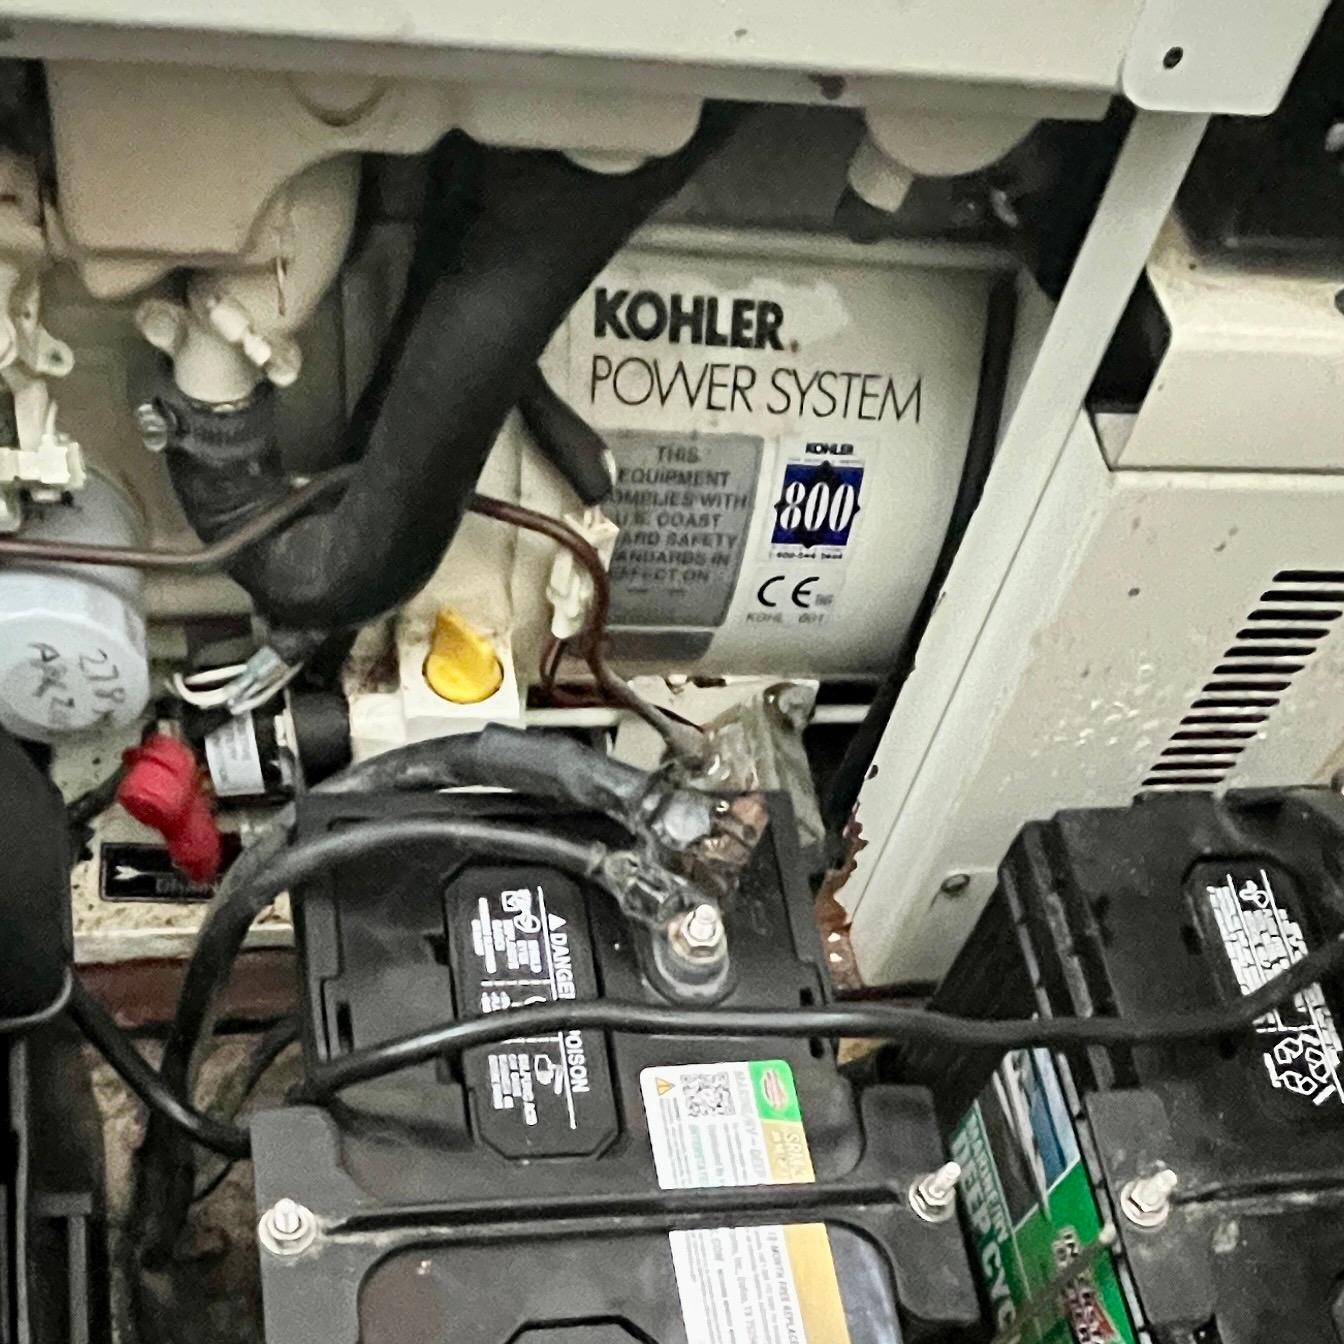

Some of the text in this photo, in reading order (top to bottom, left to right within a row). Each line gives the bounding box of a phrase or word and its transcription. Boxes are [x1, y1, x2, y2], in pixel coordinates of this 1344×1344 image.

[594, 287, 784, 351] KOHLER
[591, 355, 922, 423] POWER SYSTEM
[658, 446, 700, 463] THIS
[806, 443, 853, 455] KOHLER
[618, 468, 731, 487] EQUIPMENT
[612, 489, 747, 508] OMPLIES WITH
[780, 482, 854, 531] 800
[657, 513, 722, 528] COAST
[621, 532, 660, 545] ARD
[614, 551, 705, 565] ANDARDS
[550, 931, 589, 1093] DANGE OISON
[768, 1244, 784, 1279] MONTH
[776, 1280, 790, 1303] FREE
